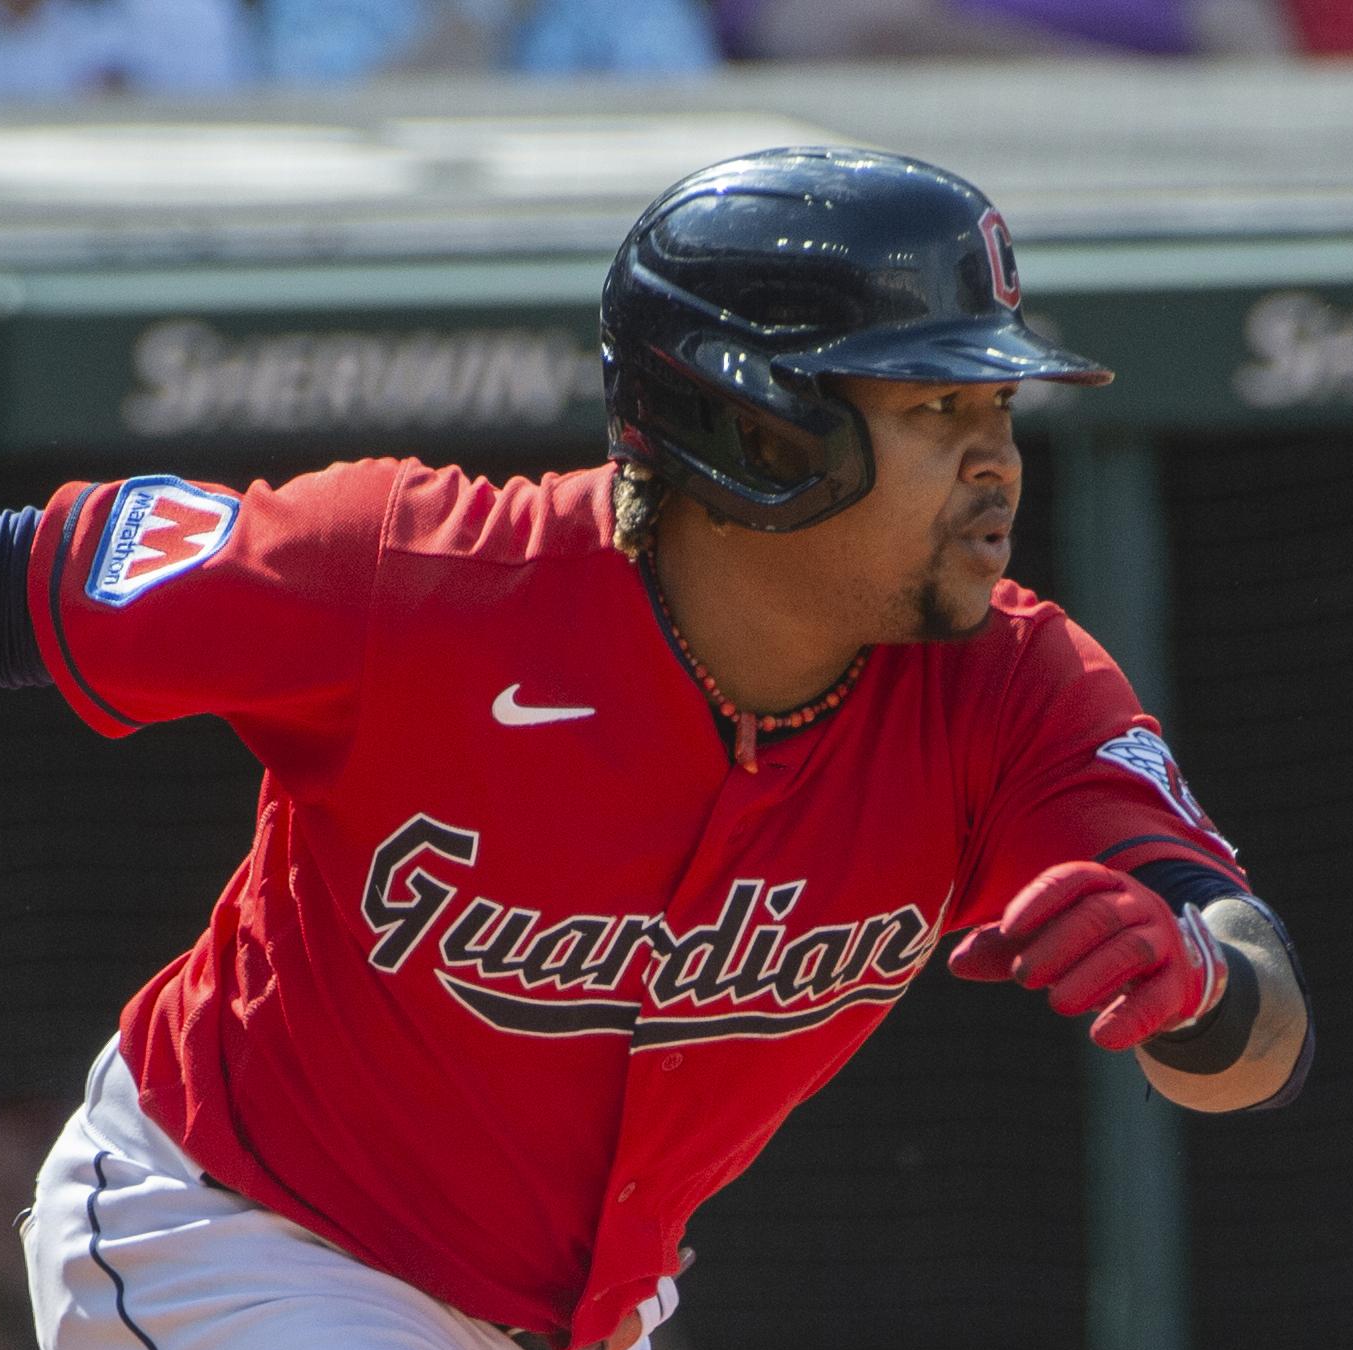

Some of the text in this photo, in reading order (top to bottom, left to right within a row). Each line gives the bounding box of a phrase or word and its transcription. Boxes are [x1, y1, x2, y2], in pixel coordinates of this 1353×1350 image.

[977, 206, 1021, 311] C
[102, 491, 155, 586] Marathon
[360, 812, 952, 1010] Guardian
